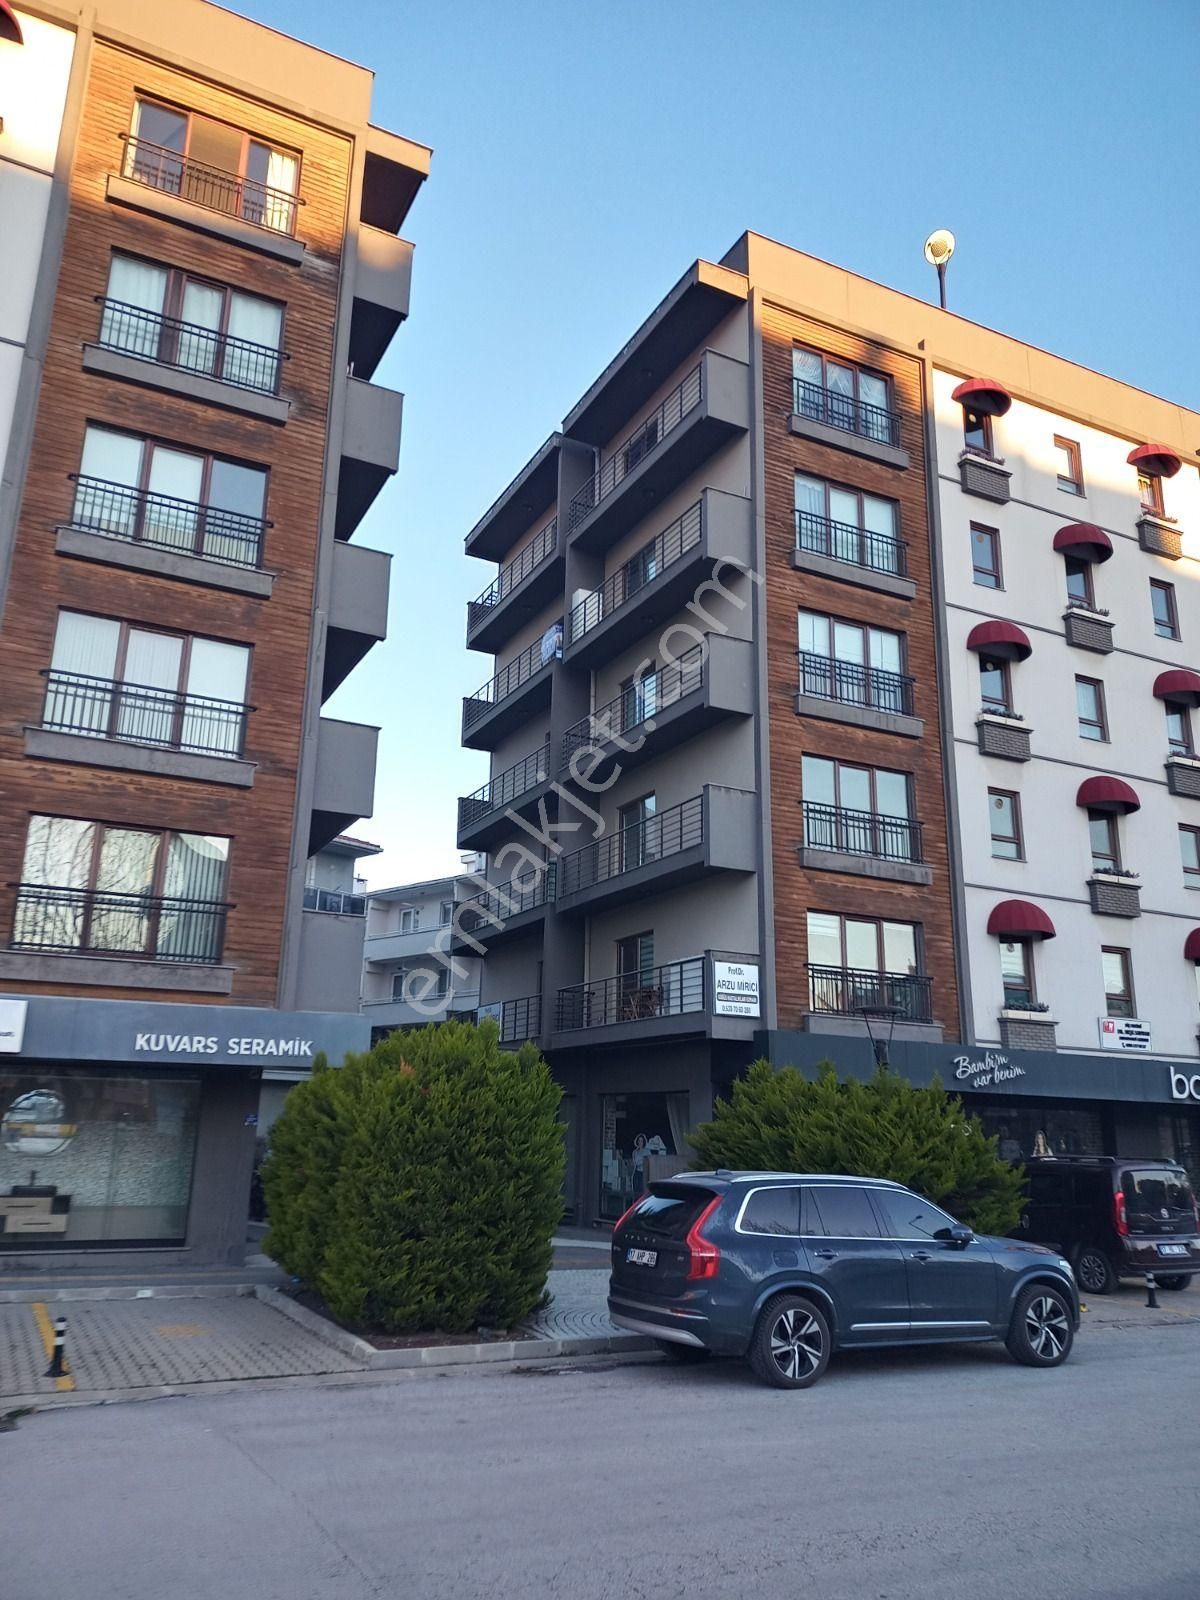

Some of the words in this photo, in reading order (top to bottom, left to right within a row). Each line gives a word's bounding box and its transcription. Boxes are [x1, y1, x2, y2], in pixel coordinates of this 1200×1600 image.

[717, 979, 735, 991] ARZU
[135, 1033, 218, 1054] KUVARS
[227, 1037, 313, 1056] SERAMİK
[974, 1074, 992, 1088] var
